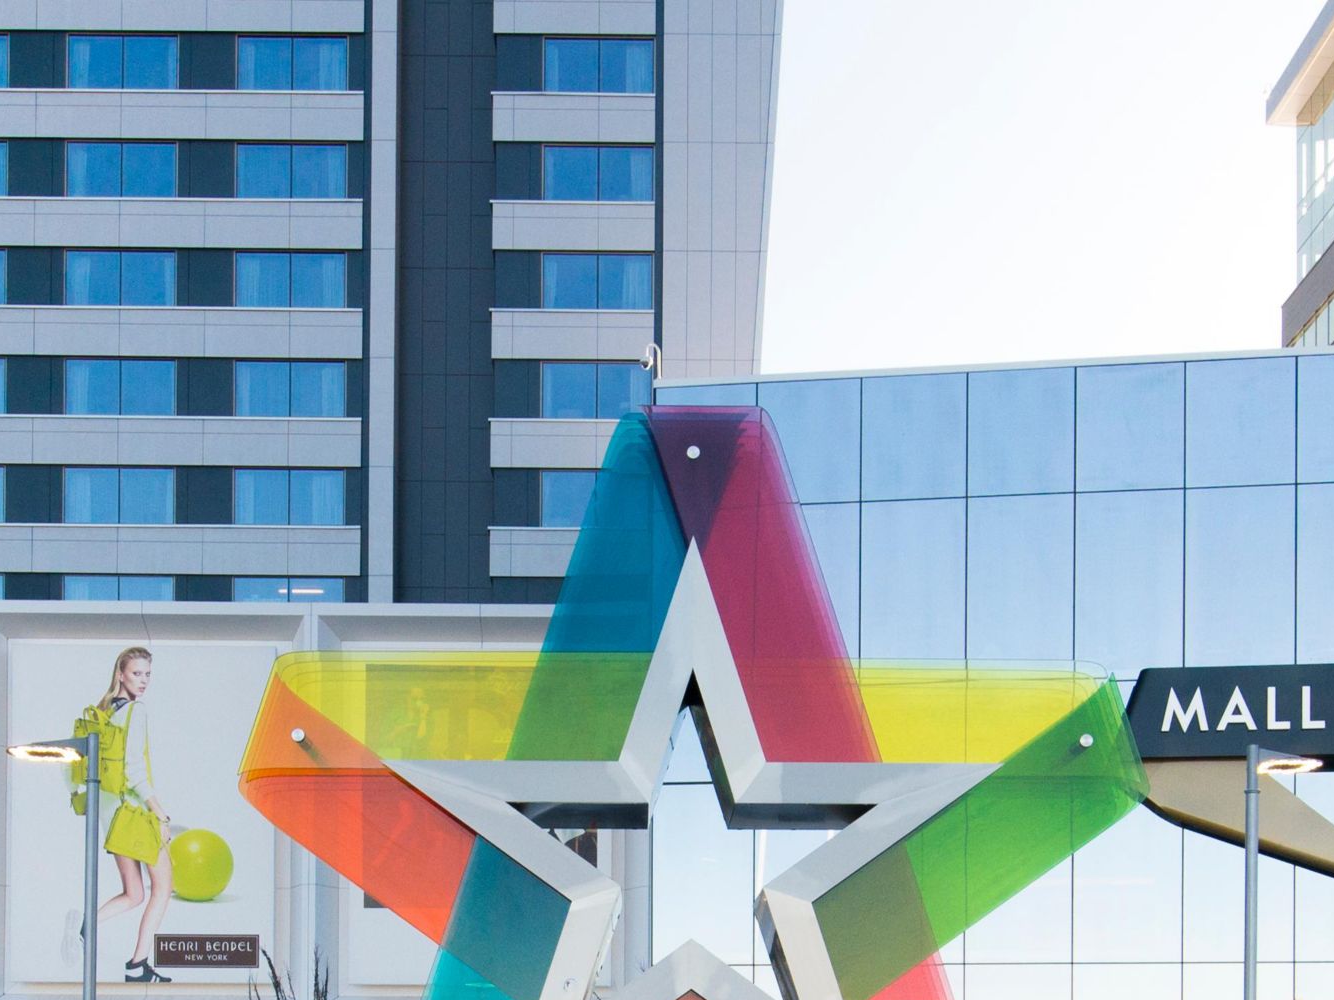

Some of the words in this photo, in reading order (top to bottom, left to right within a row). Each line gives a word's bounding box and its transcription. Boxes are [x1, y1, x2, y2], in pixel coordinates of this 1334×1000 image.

[1160, 685, 1326, 733] MALL
[160, 941, 198, 952] HENRI
[205, 941, 253, 952] BENDEL
